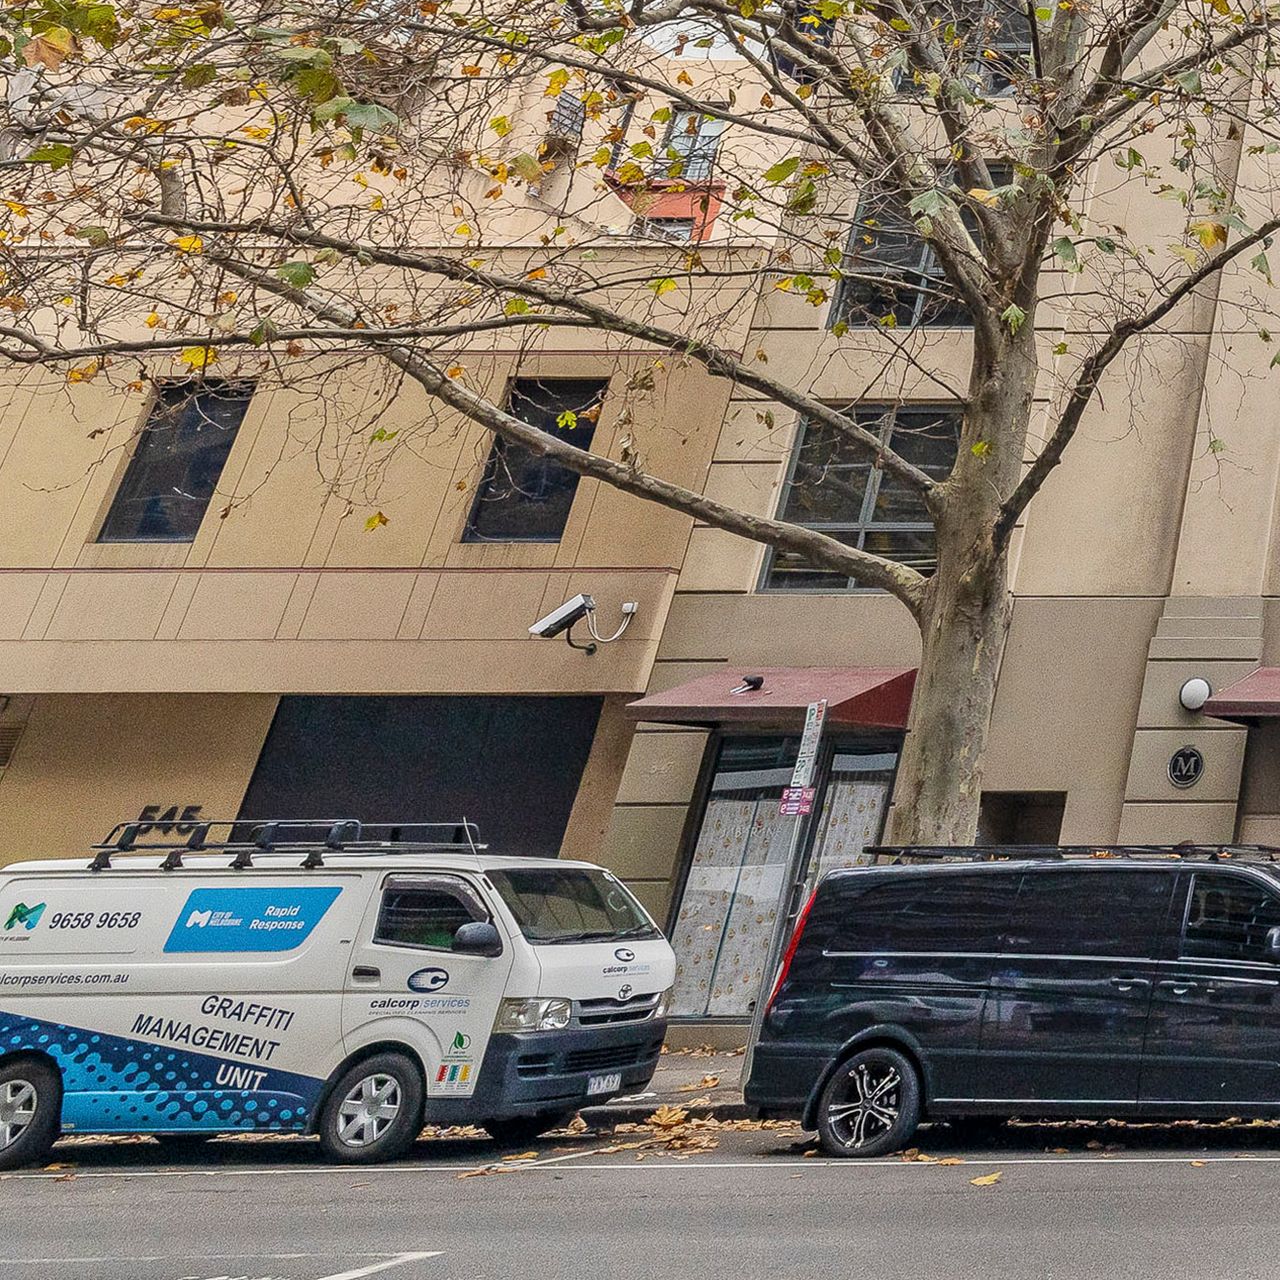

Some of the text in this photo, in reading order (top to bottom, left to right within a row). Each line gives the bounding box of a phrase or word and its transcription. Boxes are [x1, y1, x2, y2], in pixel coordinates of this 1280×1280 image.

[137, 804, 204, 836] 545
[49, 912, 95, 929] 9658
[96, 911, 142, 929] 9658
[265, 905, 301, 918] Rapid
[250, 919, 305, 932] Response
[0, 972, 130, 988] lcorpservices.com.au
[201, 995, 295, 1031] GRAFFITI
[370, 998, 471, 1010] calcorp services
[130, 1014, 281, 1061] MANAGEMENT
[215, 1064, 268, 1092] UNIT
